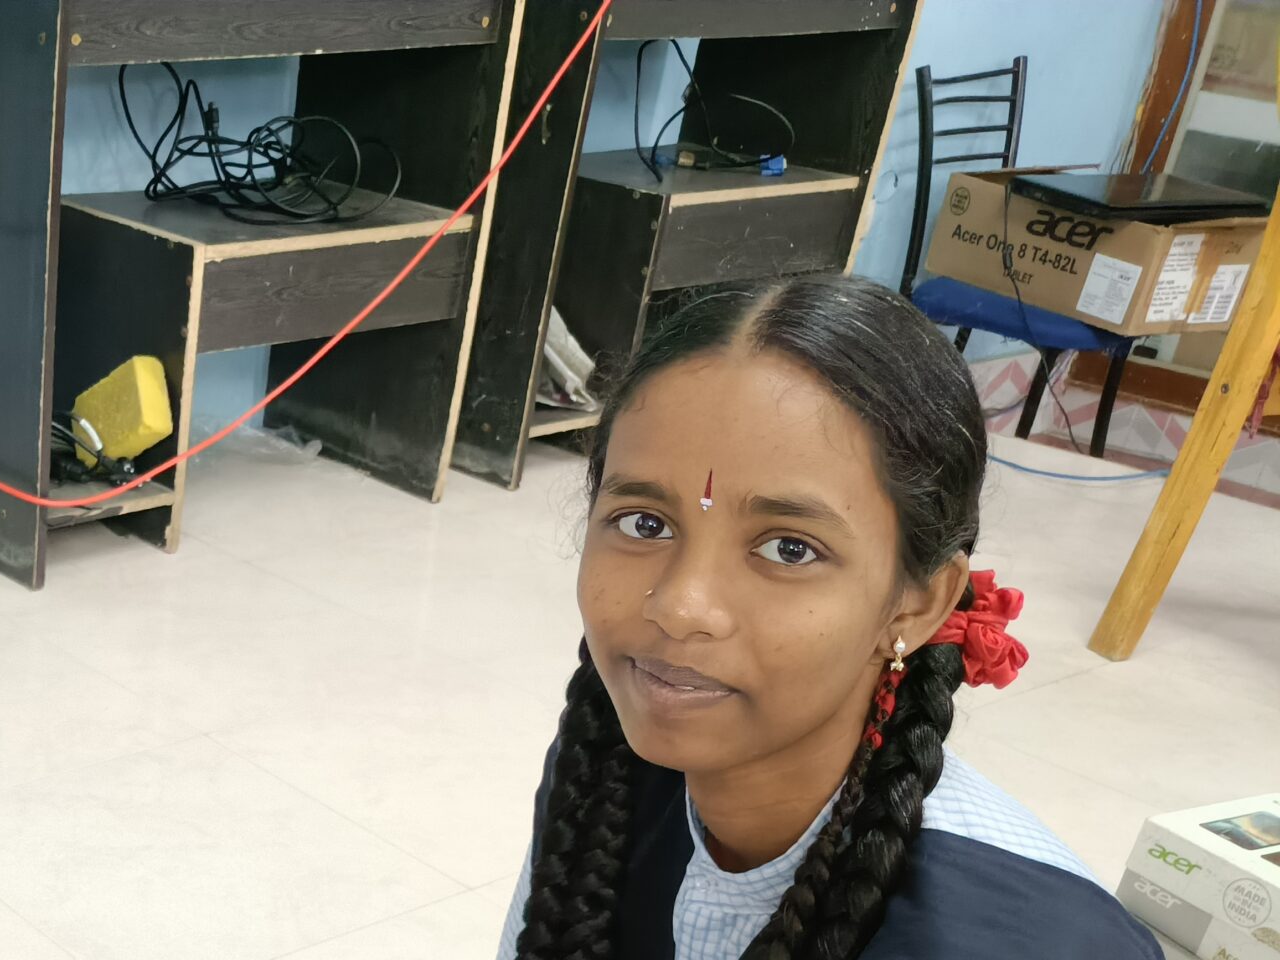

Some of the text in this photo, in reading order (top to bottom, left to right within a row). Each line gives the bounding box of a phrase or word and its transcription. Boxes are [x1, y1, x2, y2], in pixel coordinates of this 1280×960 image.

[1026, 209, 1114, 250] acer
[952, 224, 982, 246] Acer
[986, 233, 1015, 254] One
[1018, 243, 1027, 258] 8
[1031, 246, 1078, 276] T4-82L
[1148, 843, 1202, 875] acer
[1133, 881, 1182, 909] acer
[1234, 884, 1267, 907] MADE
[1240, 899, 1253, 910] IN
[1227, 900, 1258, 923] INDIA
